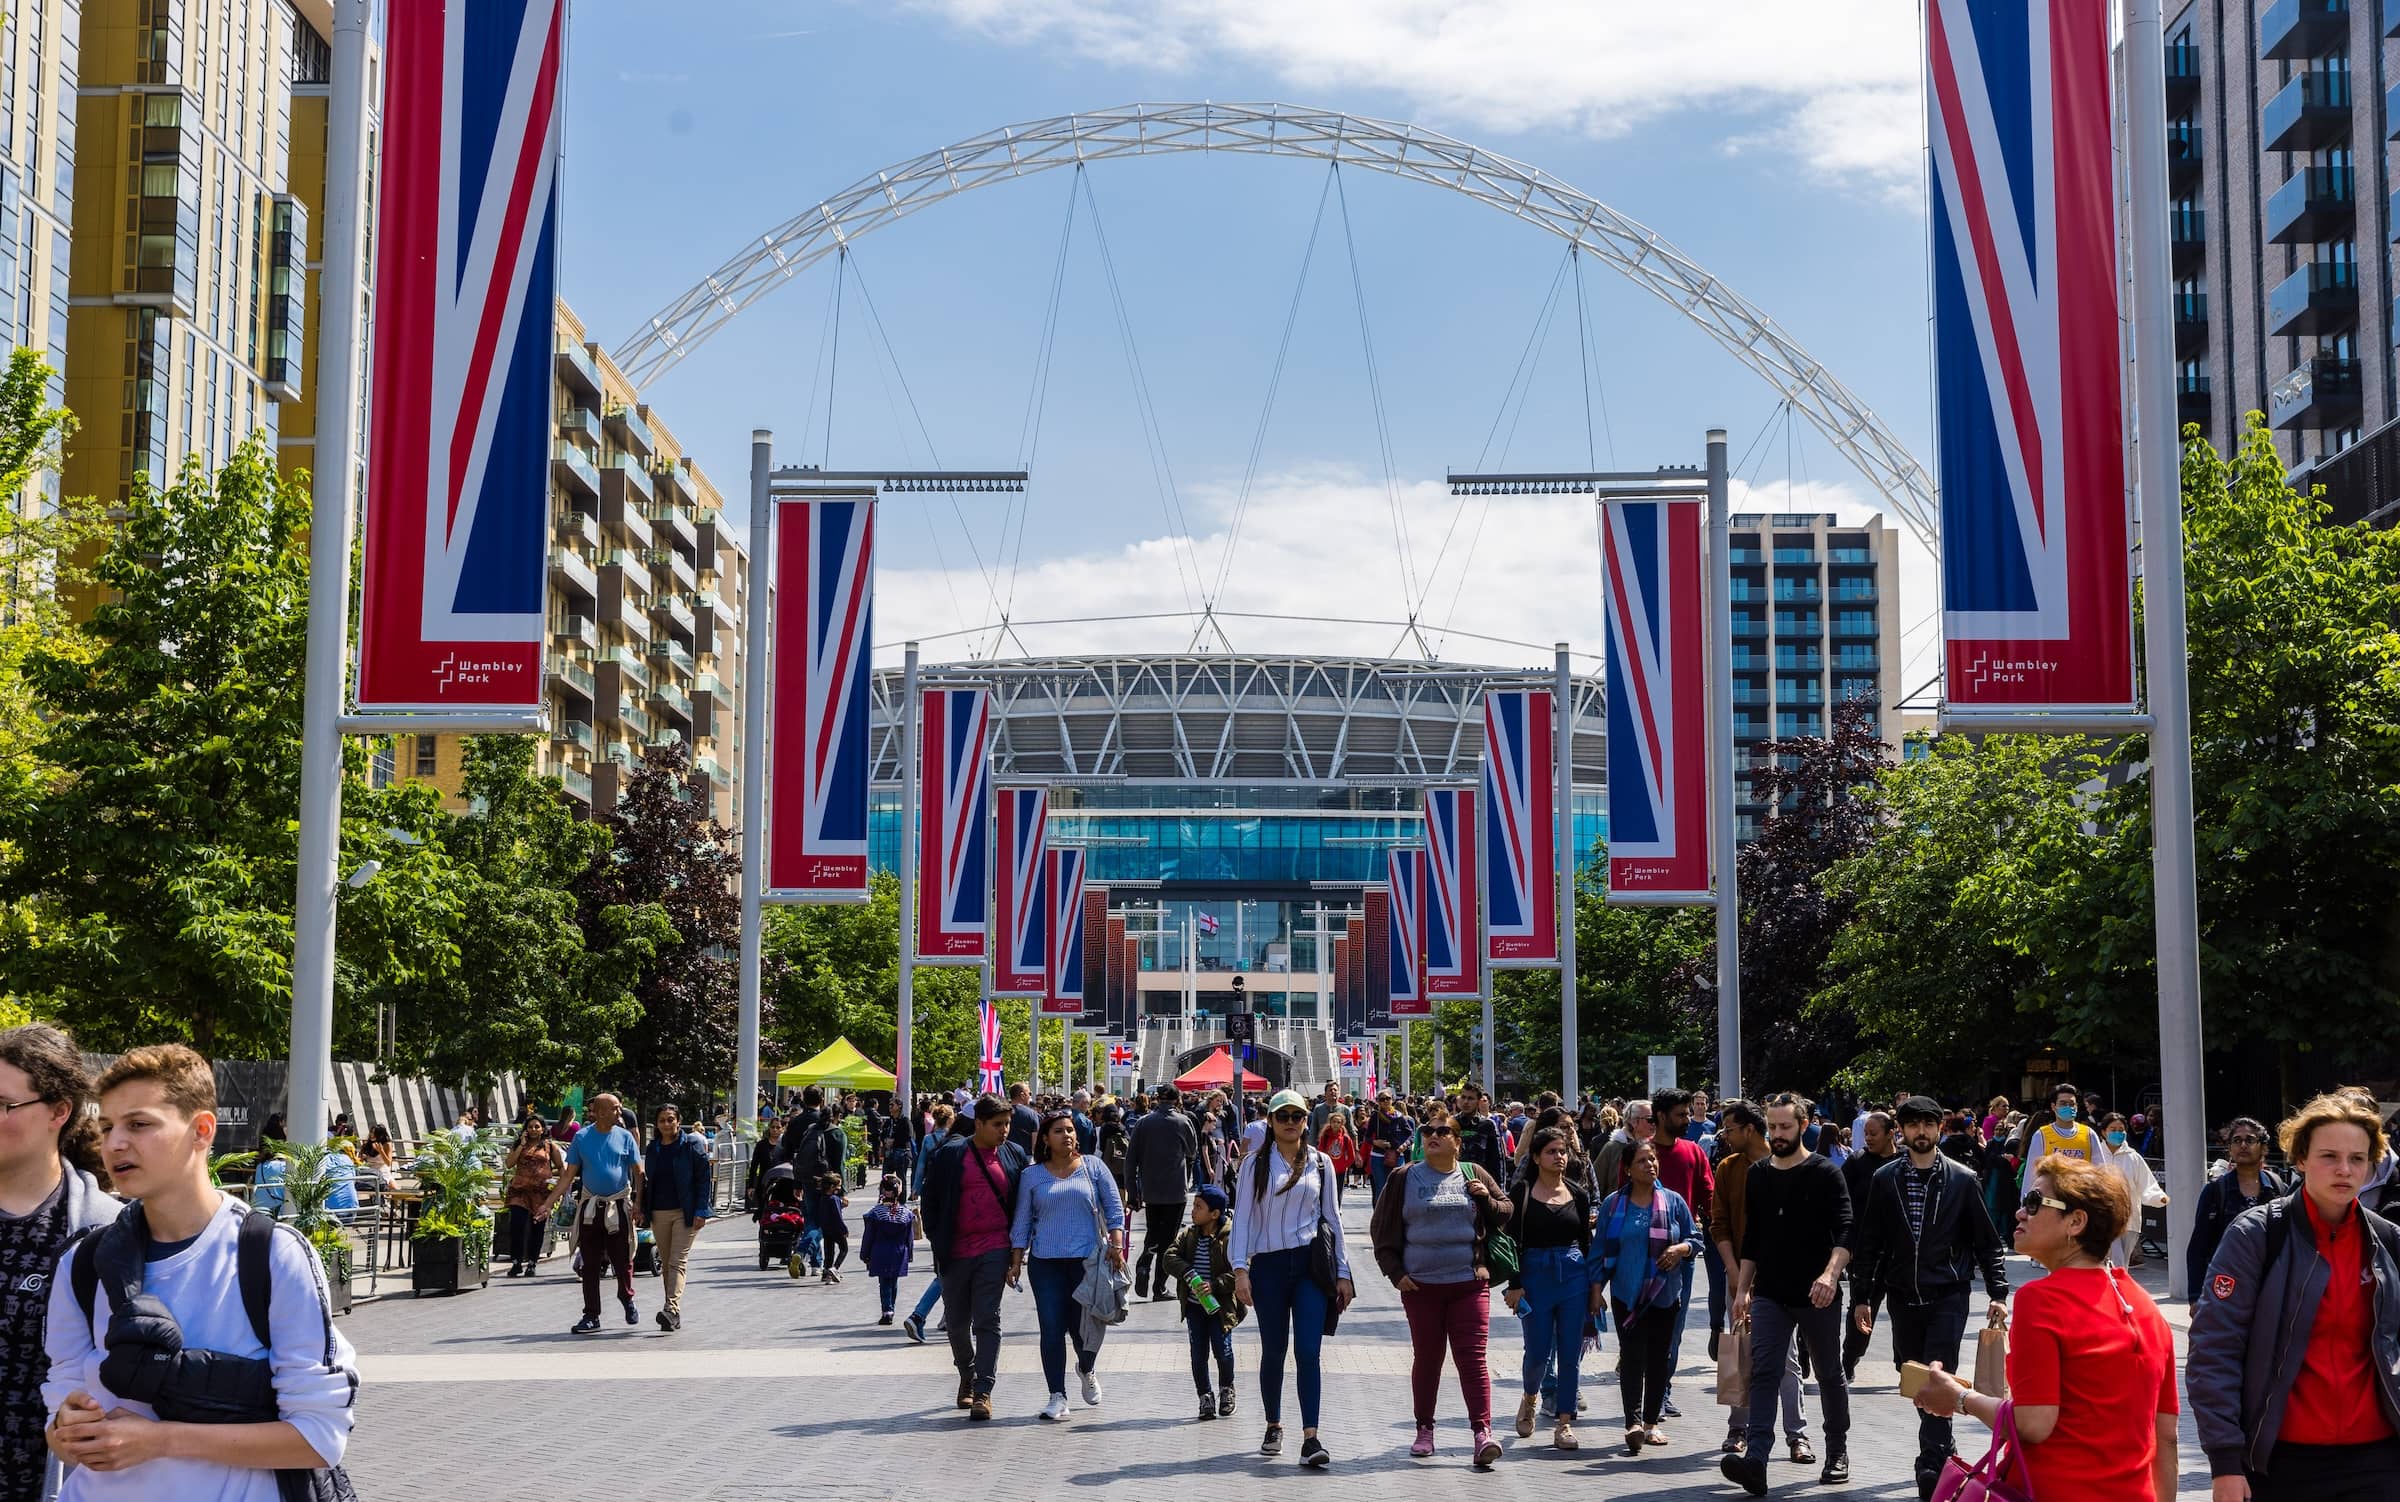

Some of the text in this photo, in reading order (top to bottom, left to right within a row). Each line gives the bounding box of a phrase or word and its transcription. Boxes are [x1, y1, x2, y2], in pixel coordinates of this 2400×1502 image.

[459, 660, 523, 673] Wembley
[1992, 660, 2058, 672] Wembley
[458, 673, 489, 683] Park
[1993, 672, 2025, 682] Park
[2053, 1147, 2084, 1159] LKERS
